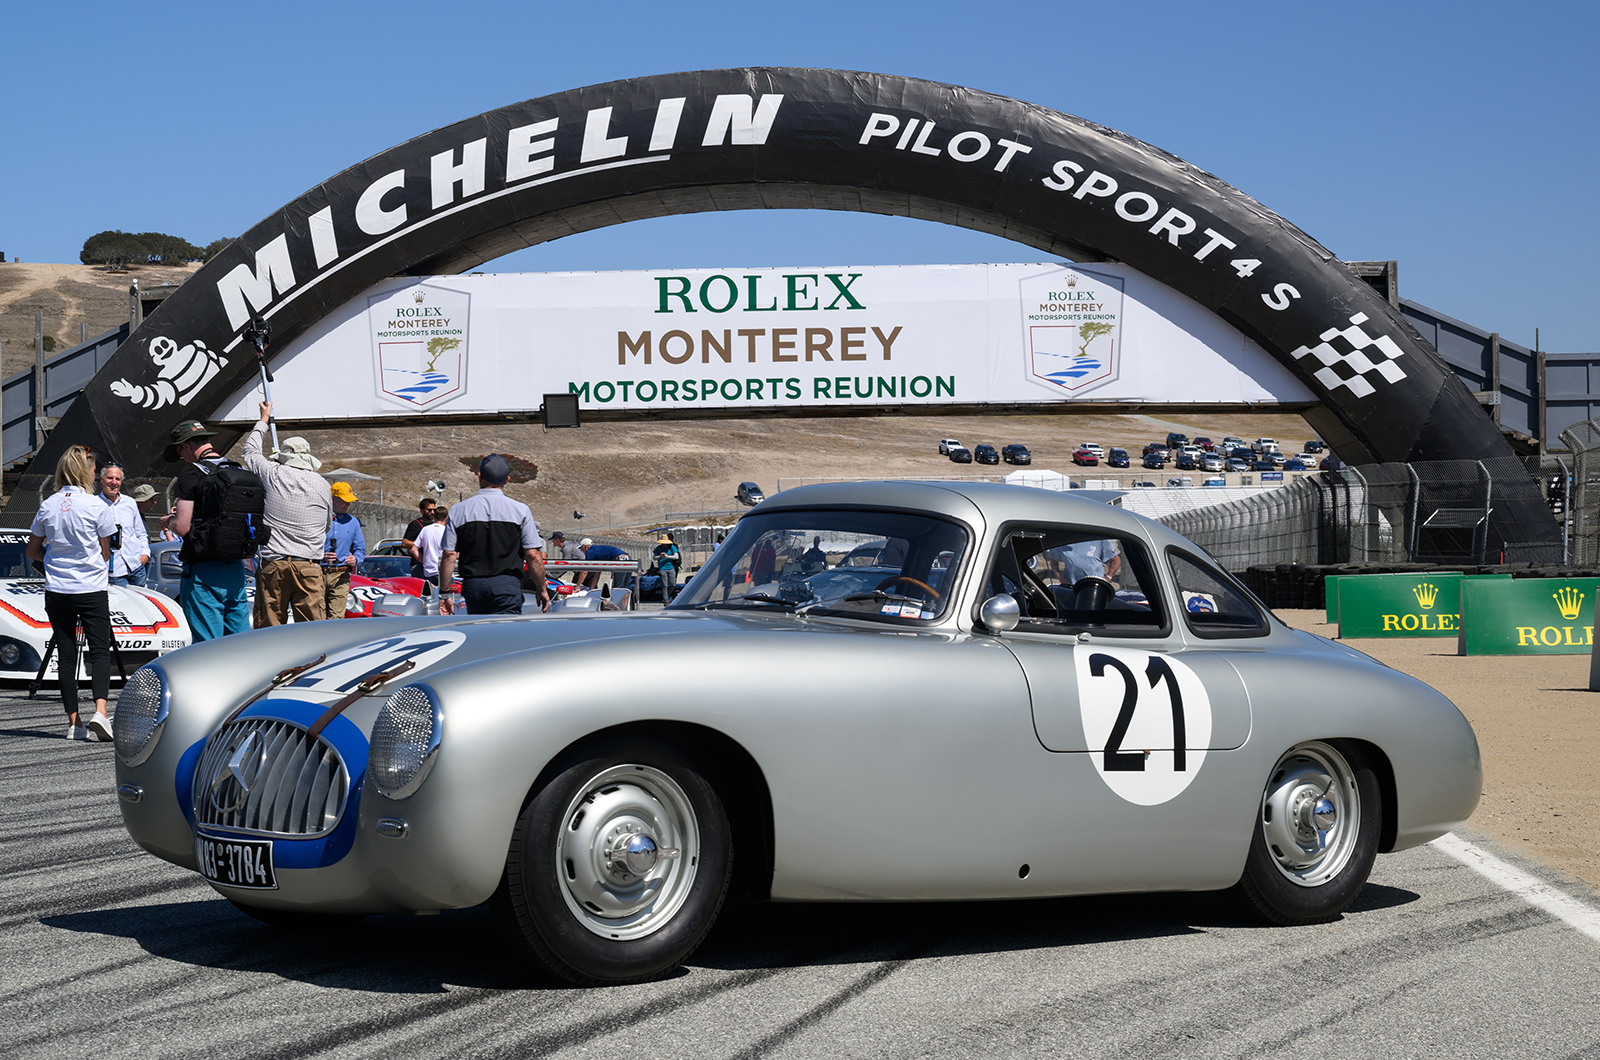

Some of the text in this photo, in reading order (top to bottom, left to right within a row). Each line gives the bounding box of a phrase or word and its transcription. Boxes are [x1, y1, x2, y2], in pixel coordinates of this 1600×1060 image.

[217, 94, 784, 332] MICHELIN
[859, 113, 1302, 311] PILOT SPORT 4 S
[654, 273, 866, 313] ROLEX
[1048, 291, 1096, 301] ROLEX
[396, 306, 443, 318] ROLEX
[1039, 303, 1104, 312] MONTEREY
[377, 328, 463, 338] MOTORSPORTS REUNION
[388, 318, 451, 329] MONTEREY
[617, 326, 903, 365] MONTEREY
[568, 375, 956, 403] MOTORSPORTS REUNION
[353, 587, 388, 601] 24
[1382, 613, 1461, 631] ROLE
[117, 640, 152, 649] NLOP
[1516, 626, 1594, 646] ROLE
[286, 638, 455, 693] 21
[1089, 653, 1187, 772] 21
